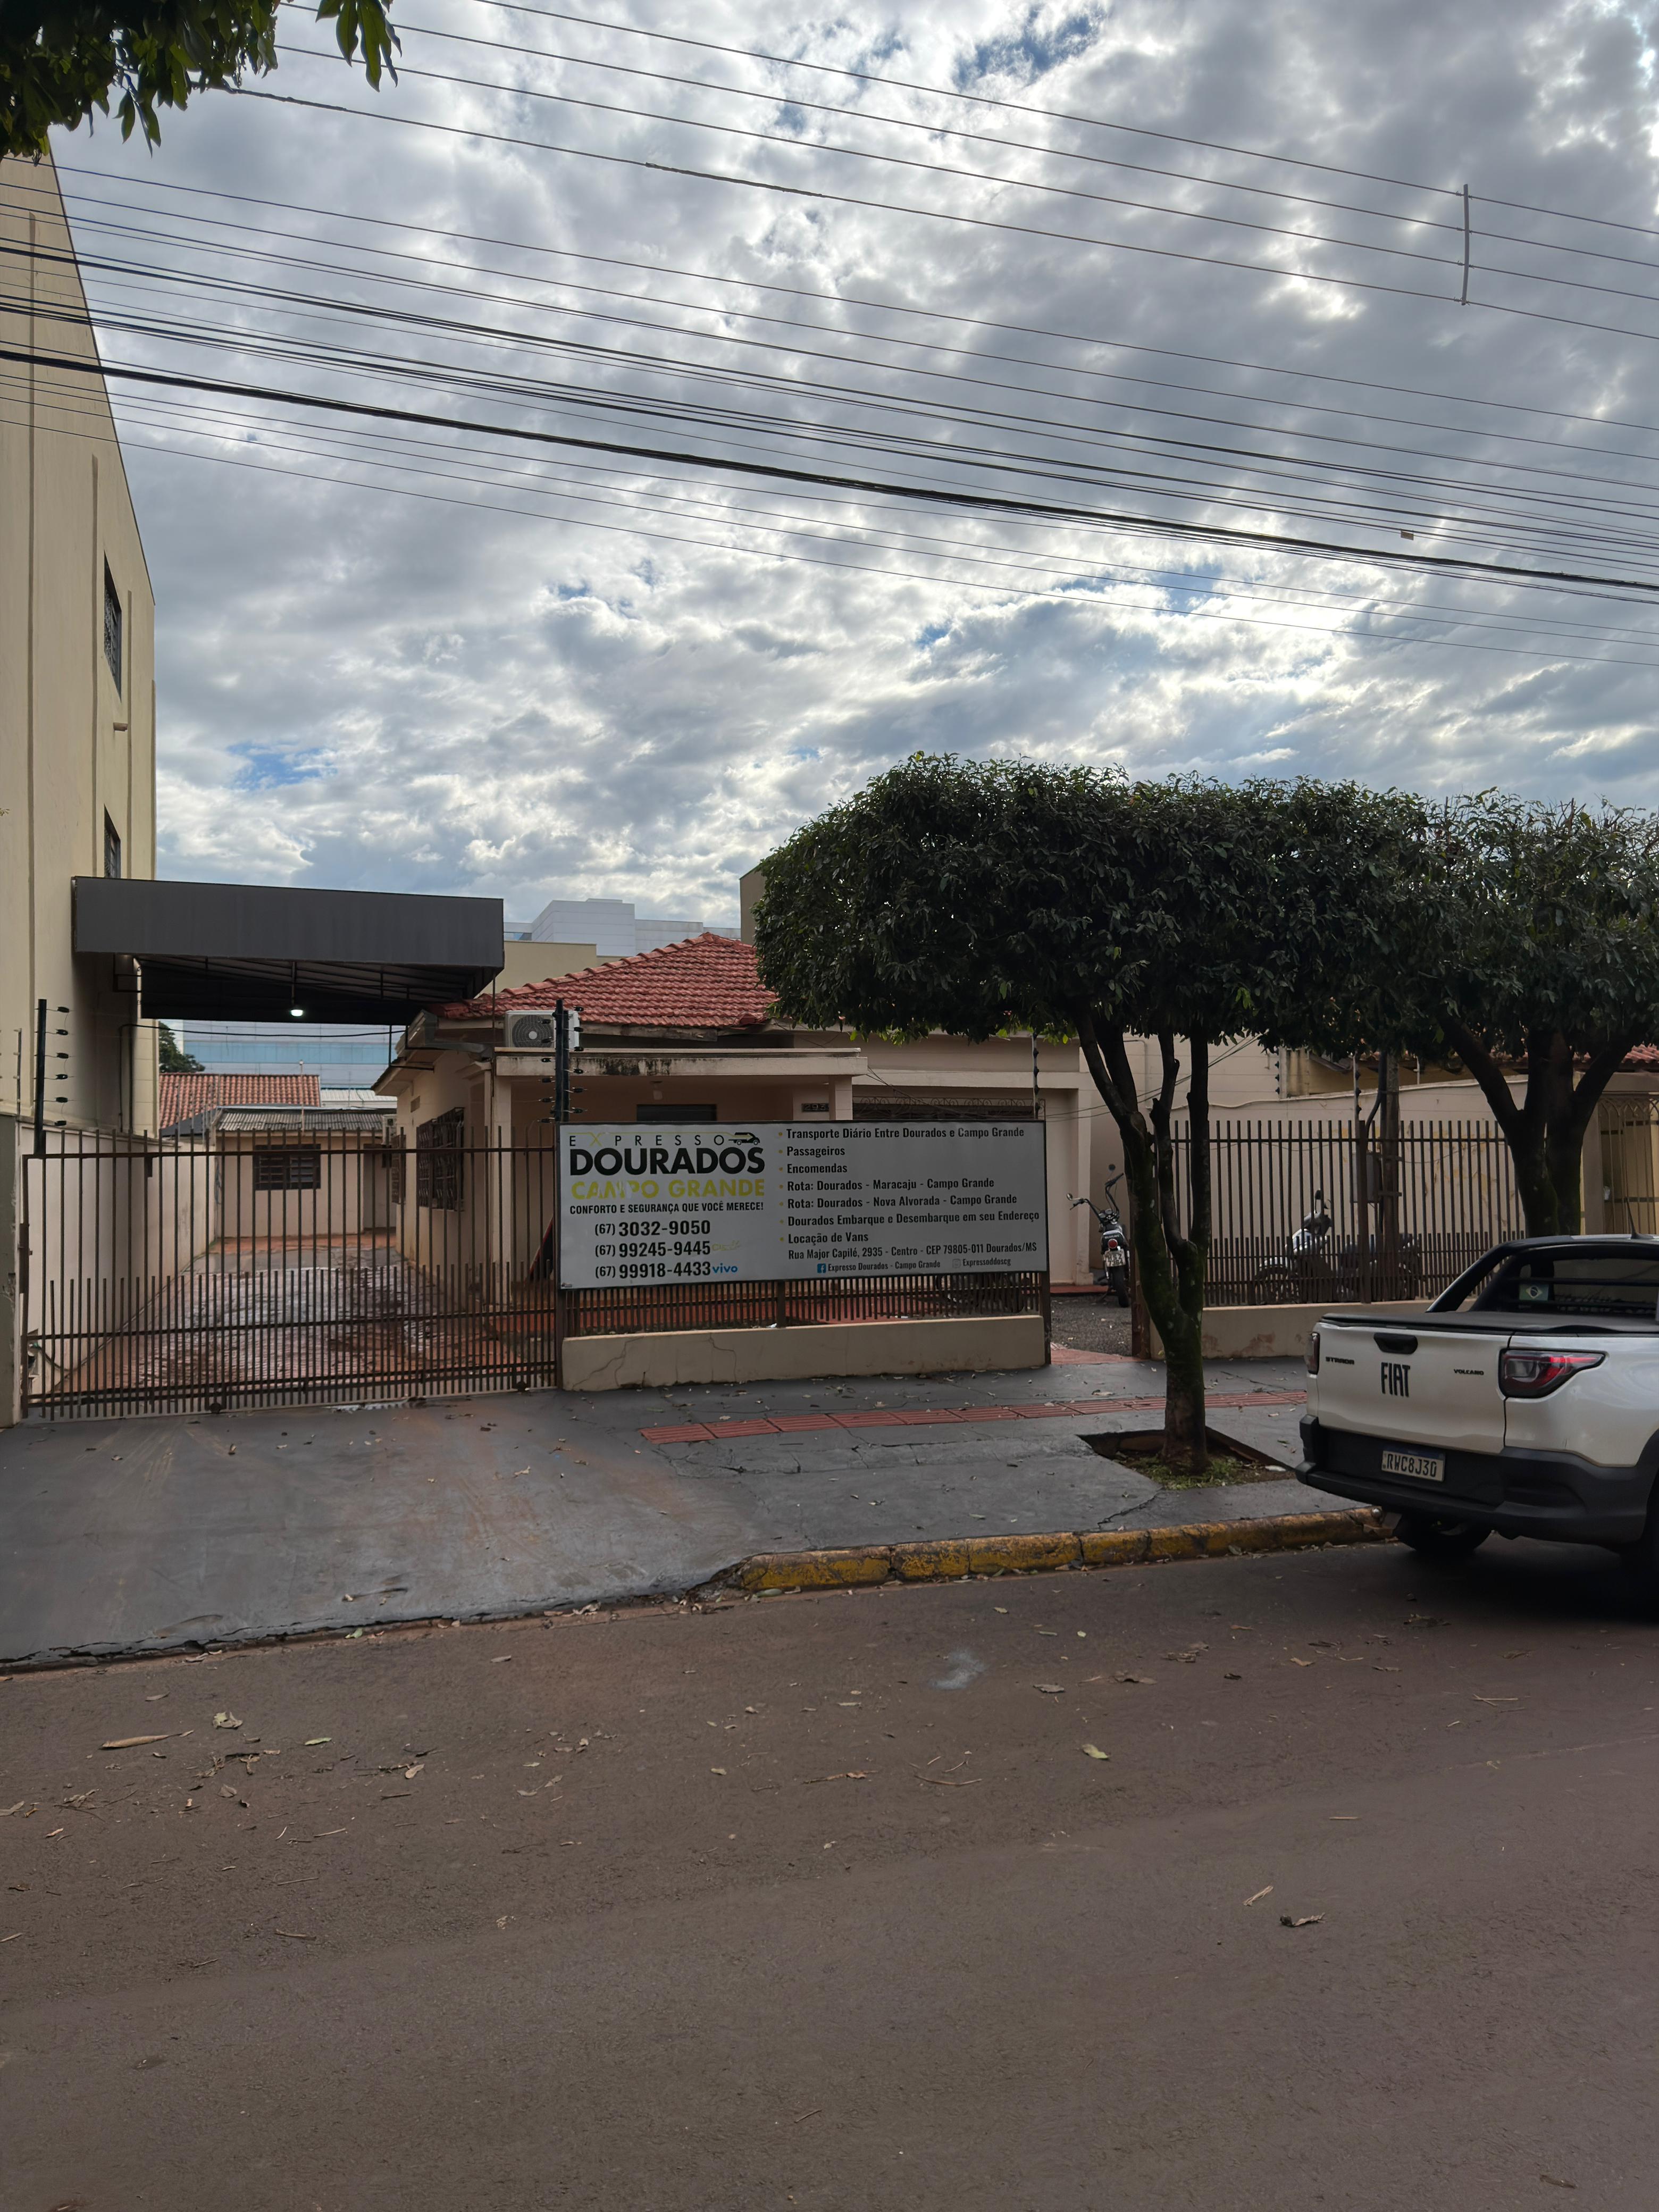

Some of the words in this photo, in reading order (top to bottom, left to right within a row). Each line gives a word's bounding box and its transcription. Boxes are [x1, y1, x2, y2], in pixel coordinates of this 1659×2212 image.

[569, 1133, 724, 1147] EXPRESSO
[786, 1128, 839, 1141] Transporte
[843, 1128, 872, 1138] Diário
[875, 1128, 899, 1138] Entre
[903, 1128, 946, 1138] Dourados
[958, 1128, 988, 1138] Campo
[992, 1128, 1024, 1137] Grande
[787, 1146, 845, 1158] Passageiros
[570, 1147, 765, 1175] DOURADOS
[787, 1163, 847, 1174] Encomendas
[668, 1179, 764, 1197] GRANDE
[787, 1181, 814, 1191] Rota:
[817, 1180, 862, 1191] Dourados
[873, 1179, 916, 1191] Maracaju
[927, 1179, 958, 1190] Campo
[962, 1178, 994, 1188] Grande
[570, 1204, 617, 1214] CONFORTO
[621, 1204, 625, 1213] E
[628, 1203, 679, 1214] SEGURANÇA
[682, 1203, 699, 1212] QUE
[701, 1201, 724, 1212] VOCÊ
[726, 1202, 764, 1211] MERECE!
[788, 1198, 814, 1209] Rota:
[817, 1197, 862, 1208] Dourados
[873, 1197, 895, 1206] Nova
[899, 1195, 940, 1206] Alvorada
[950, 1195, 981, 1206] Campo
[985, 1195, 1017, 1204] Grande
[788, 1216, 834, 1226] Dourados
[837, 1215, 884, 1226] Embarque
[896, 1212, 960, 1225] Desembarque
[963, 1213, 976, 1222] em
[979, 1212, 995, 1221] seu
[998, 1211, 1039, 1222] Endereço
[594, 1224, 615, 1236] (67)
[619, 1220, 710, 1237] 3032-9050
[788, 1233, 827, 1245] Locação
[831, 1233, 842, 1243] de
[845, 1231, 869, 1243] Vans
[595, 1244, 616, 1258] (67)
[619, 1241, 710, 1258] 99245-9445
[789, 1250, 804, 1260] Rua
[807, 1249, 829, 1261] Major
[832, 1247, 860, 1259] Capilé,
[862, 1247, 883, 1257] 2935
[891, 1246, 917, 1256] Centro
[926, 1245, 941, 1255] CEP
[943, 1244, 984, 1254] 79805-011
[986, 1243, 1037, 1253] Dourados/MS
[595, 1265, 616, 1278] (67)
[619, 1261, 711, 1278] 99918-4433
[713, 1263, 738, 1273] vivo
[828, 1264, 856, 1273] Expresso
[894, 1261, 917, 1271] Campo
[1381, 1362, 1411, 1397] FIAT
